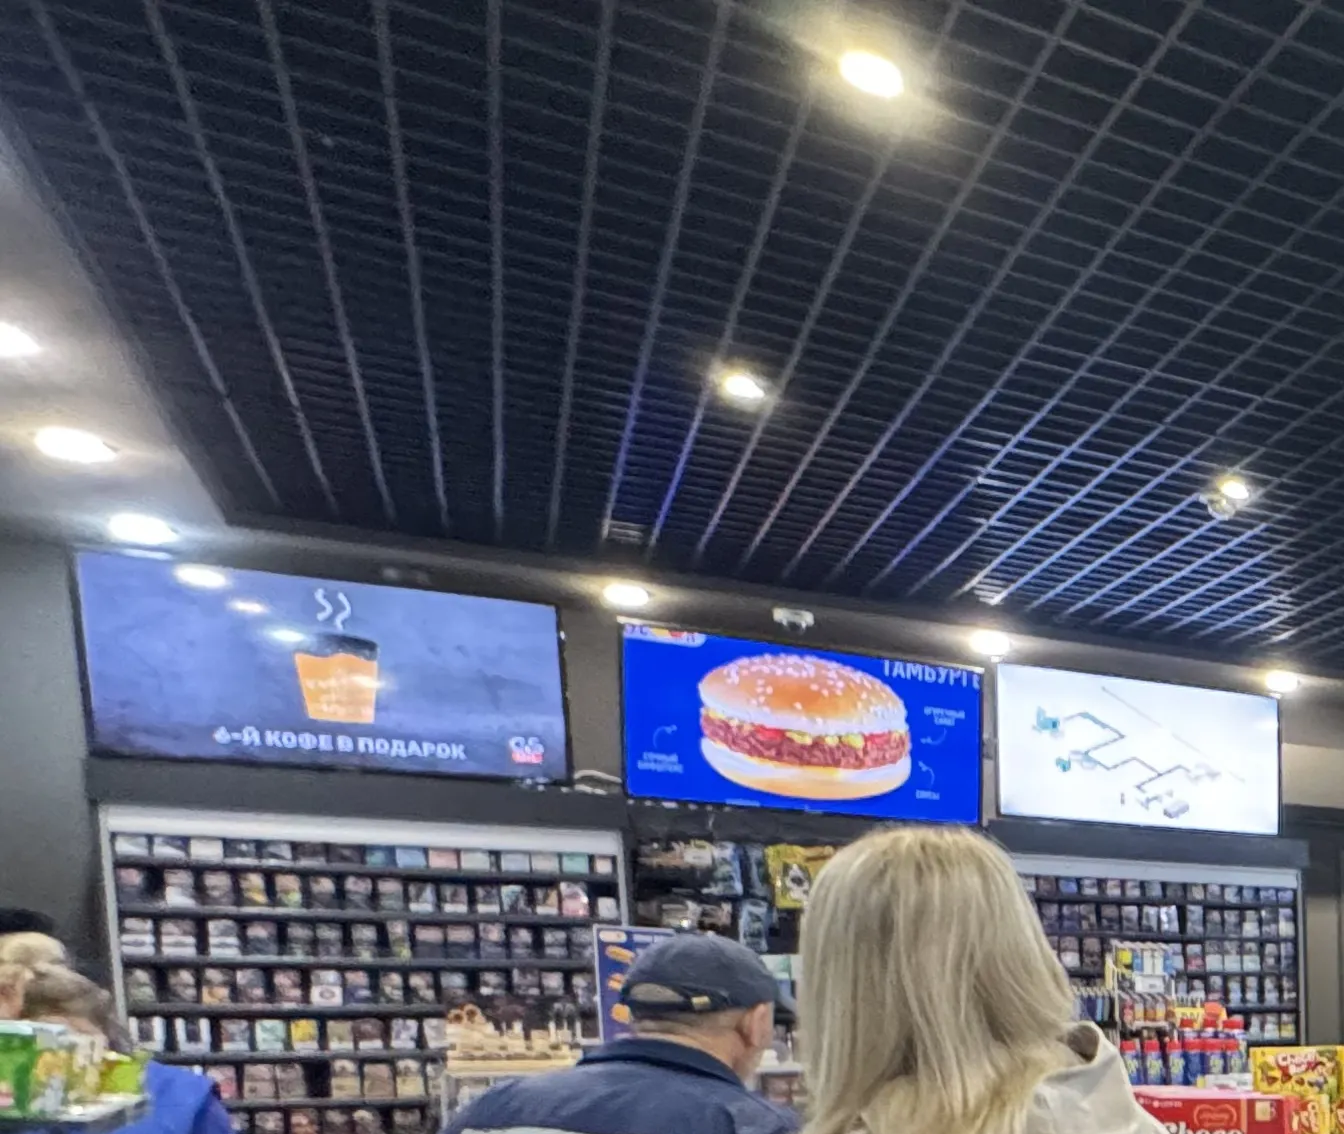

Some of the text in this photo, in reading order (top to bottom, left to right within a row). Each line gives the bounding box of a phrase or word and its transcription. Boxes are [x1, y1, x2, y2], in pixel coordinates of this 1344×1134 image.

[264, 730, 333, 752] КОФЕ
[337, 735, 354, 753] В
[358, 737, 468, 761] ПОДАРОК
